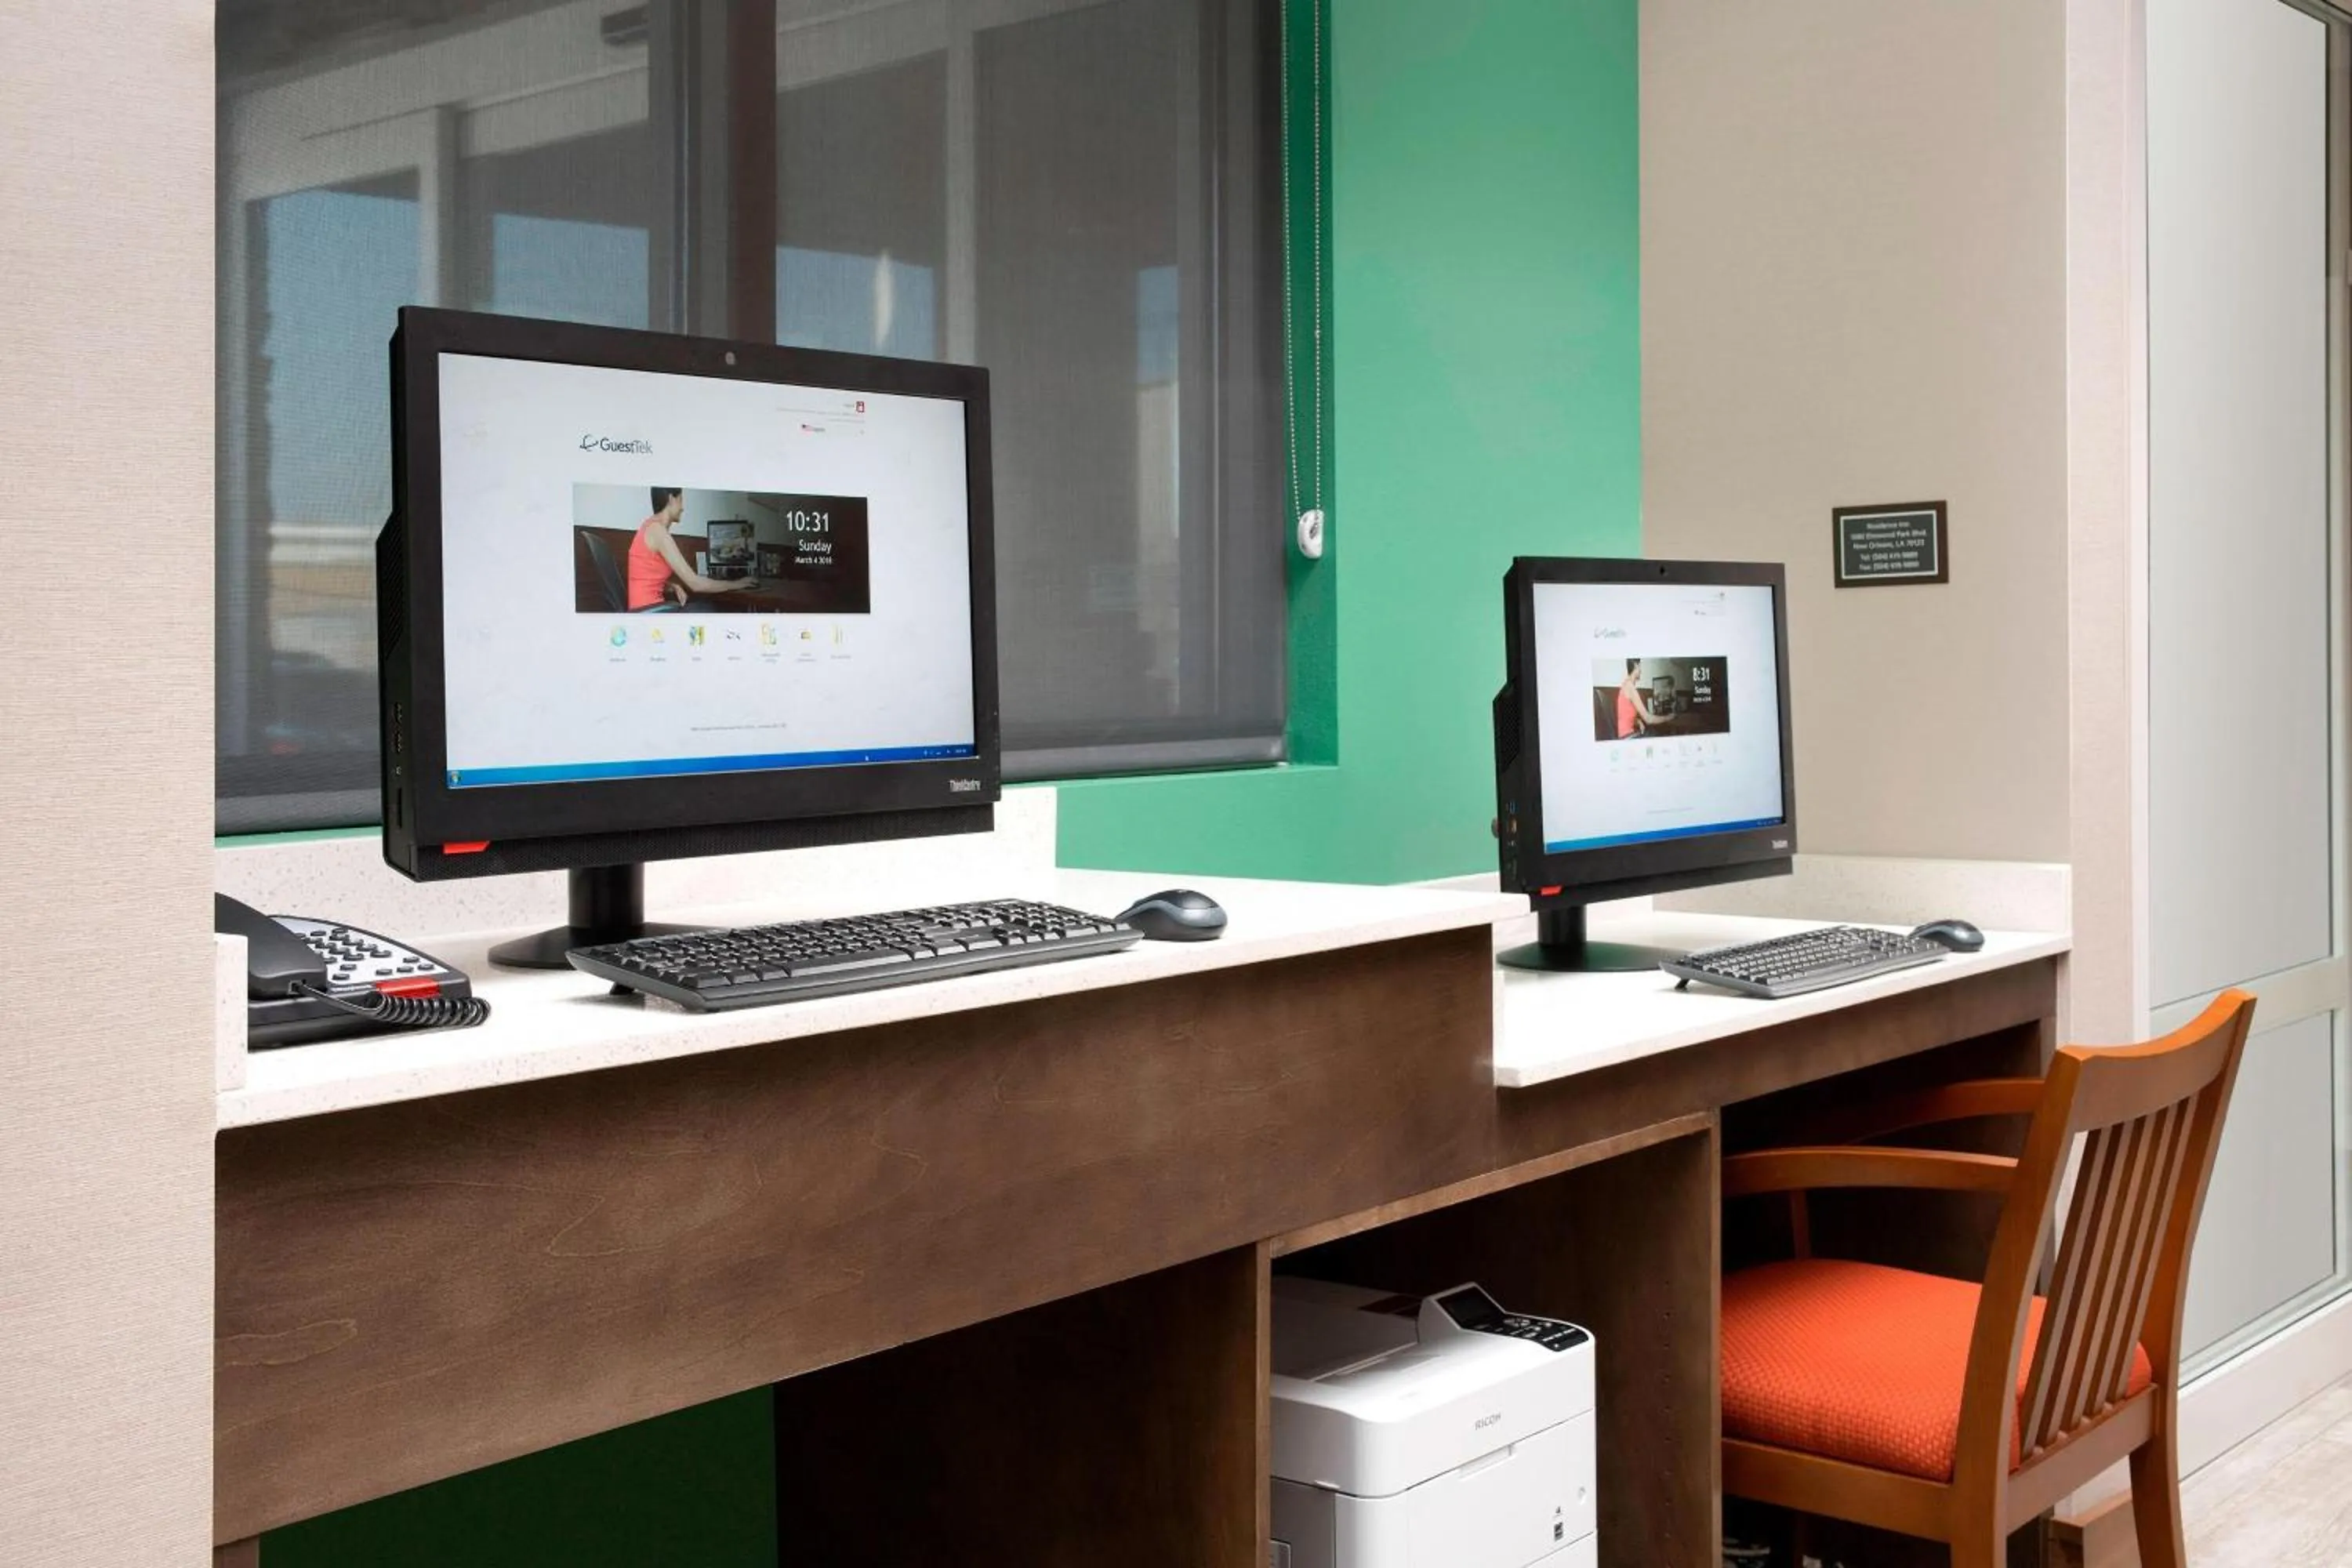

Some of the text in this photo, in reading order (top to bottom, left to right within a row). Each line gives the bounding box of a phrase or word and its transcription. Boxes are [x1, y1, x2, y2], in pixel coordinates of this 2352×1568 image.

[600, 437, 653, 454] GuestTek
[786, 510, 829, 532] 10:31
[799, 539, 832, 554] Sunday
[1693, 667, 1710, 681] 8:31
[1475, 1412, 1501, 1431] RICOH
